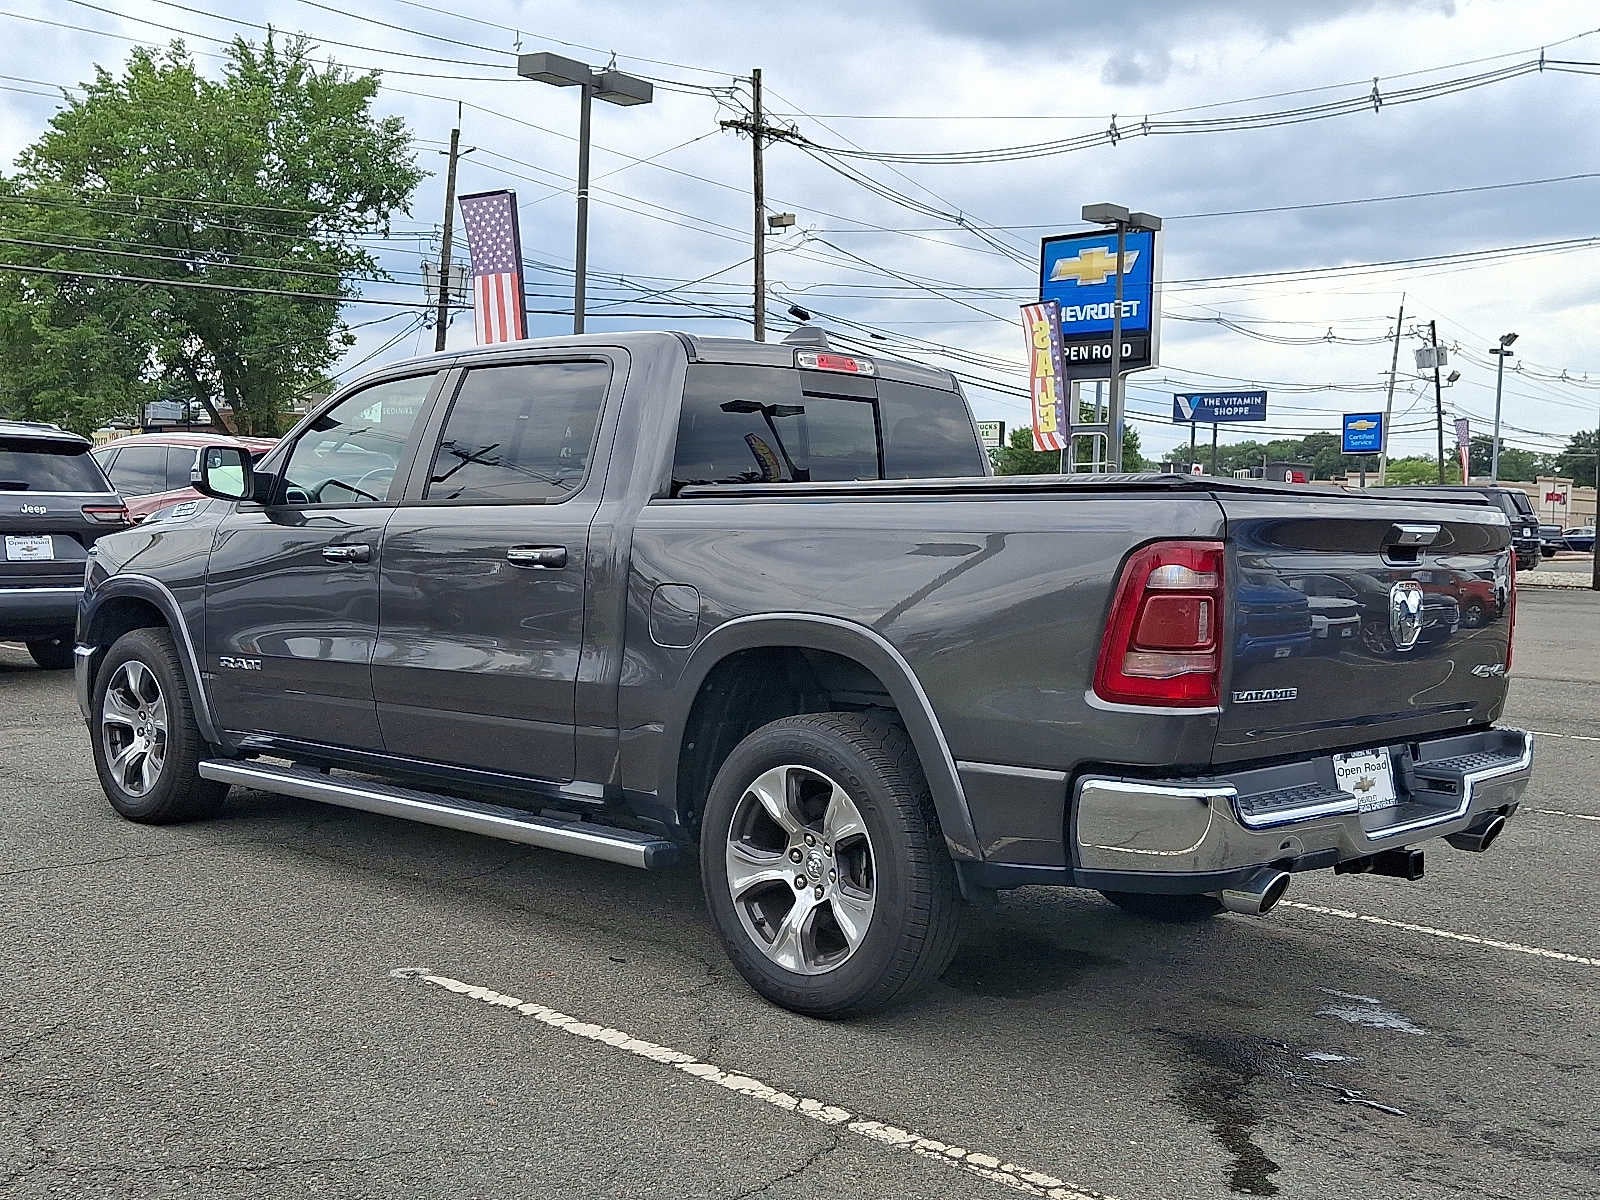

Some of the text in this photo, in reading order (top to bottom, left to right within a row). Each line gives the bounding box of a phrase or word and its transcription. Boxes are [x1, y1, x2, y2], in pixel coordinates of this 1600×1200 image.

[1064, 343, 1132, 361] PEN ROD
[1204, 397, 1261, 406] THE VITAMIN
[1214, 407, 1249, 415] SHOPPE
[21, 504, 47, 514] Jeep
[220, 656, 261, 670] RAM
[1232, 688, 1298, 703] LARAMIE
[1337, 760, 1387, 778] Open Road
